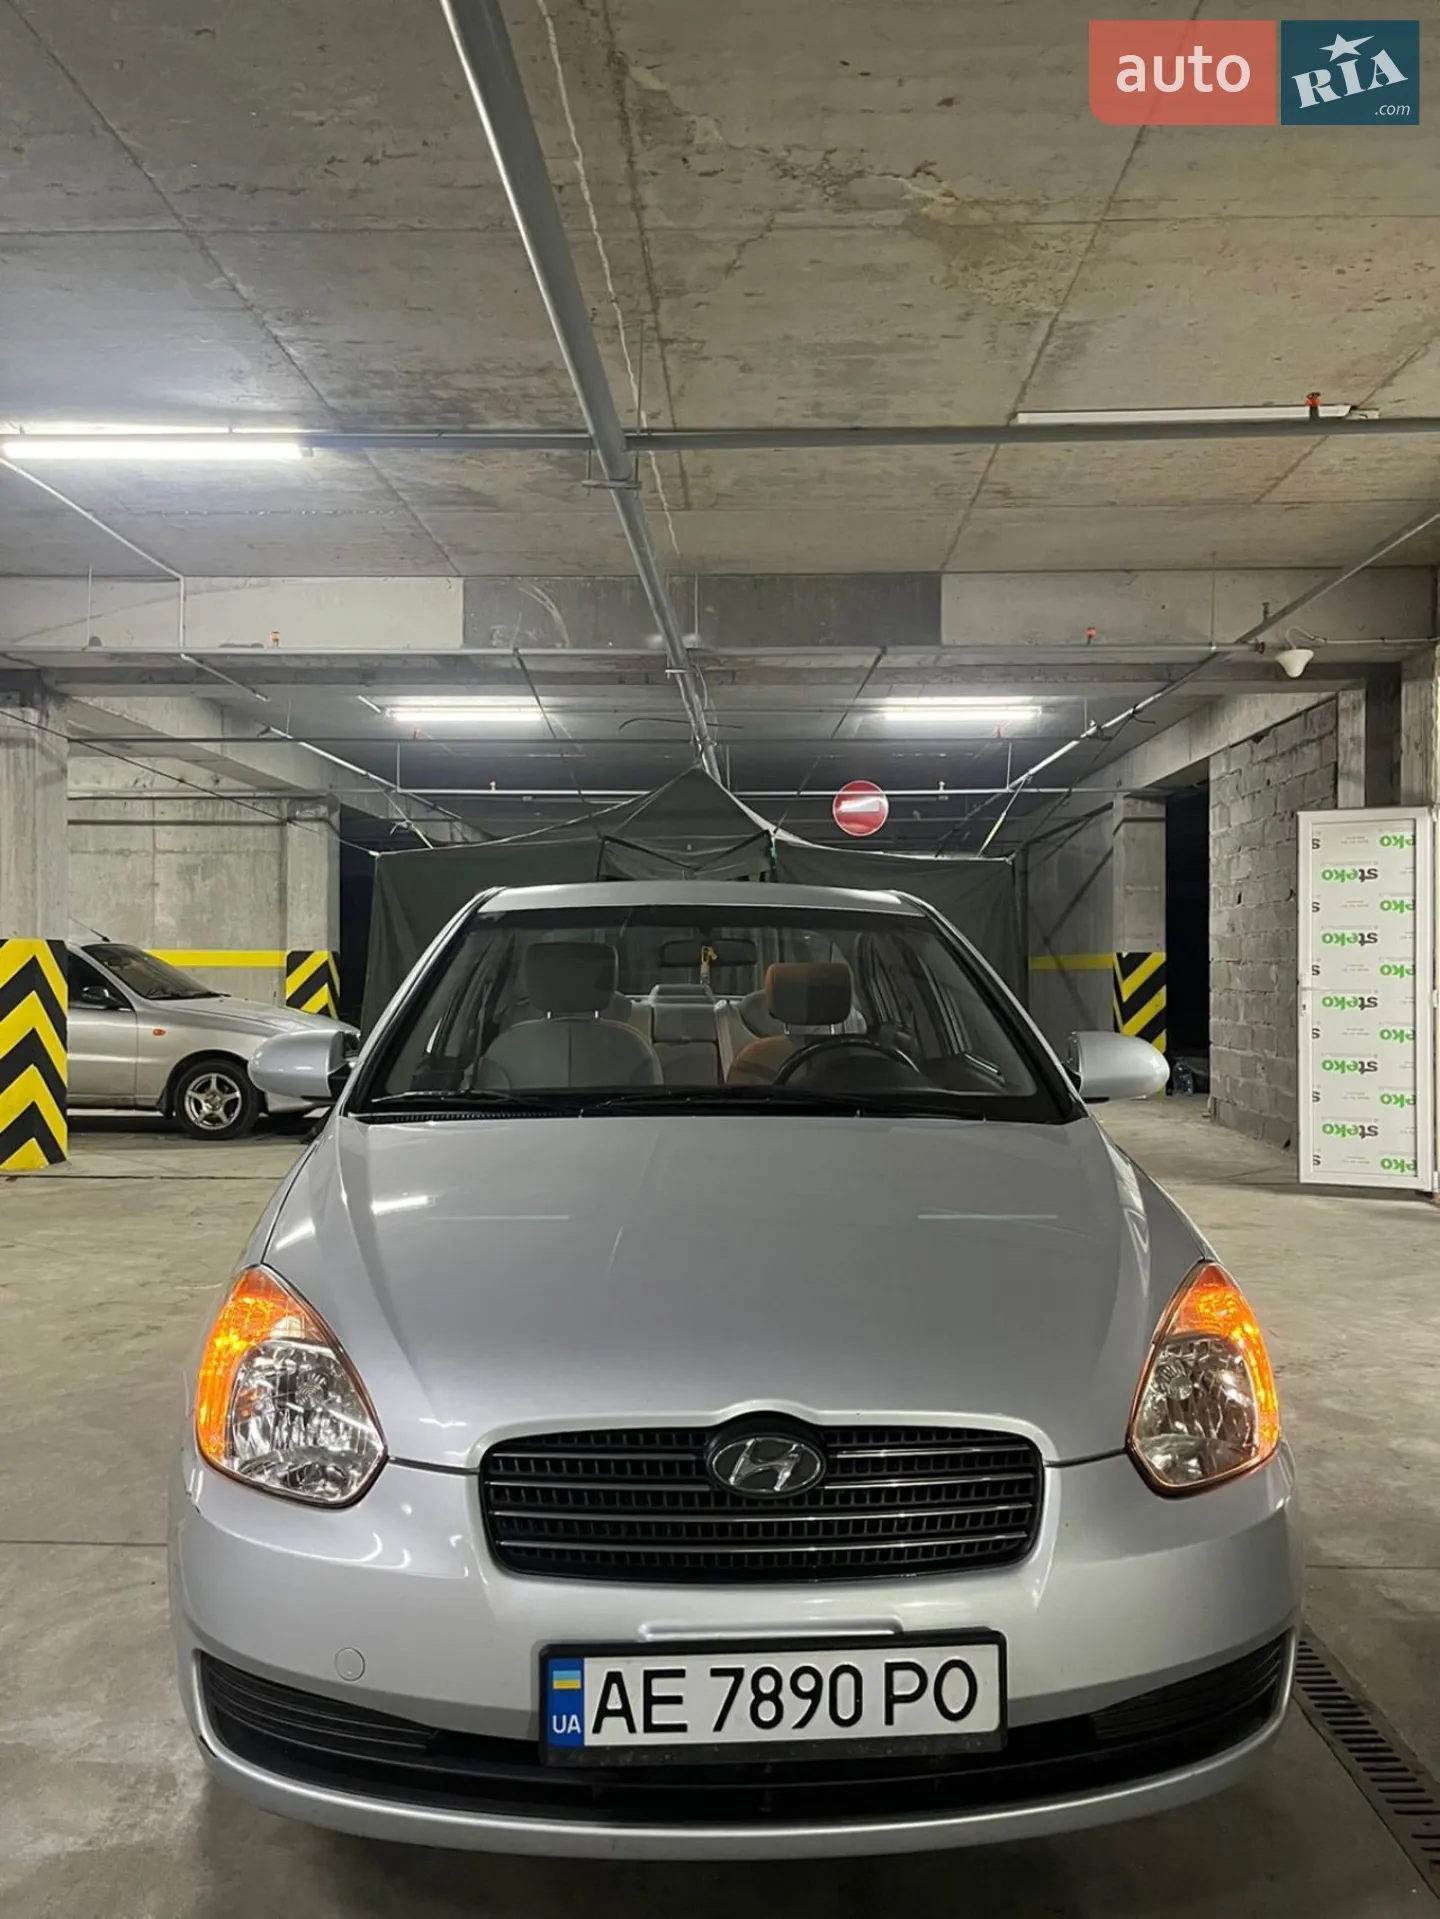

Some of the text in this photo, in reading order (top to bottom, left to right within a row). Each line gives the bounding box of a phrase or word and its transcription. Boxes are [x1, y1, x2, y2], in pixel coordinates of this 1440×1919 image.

[1321, 868, 1378, 883] steko
[1321, 932, 1378, 947] steko
[1321, 996, 1378, 1011] steko
[1321, 1059, 1378, 1075] steko
[1322, 1123, 1379, 1139] steko
[591, 1658, 979, 1734] AE 7890 PO
[552, 1714, 581, 1734] UA
